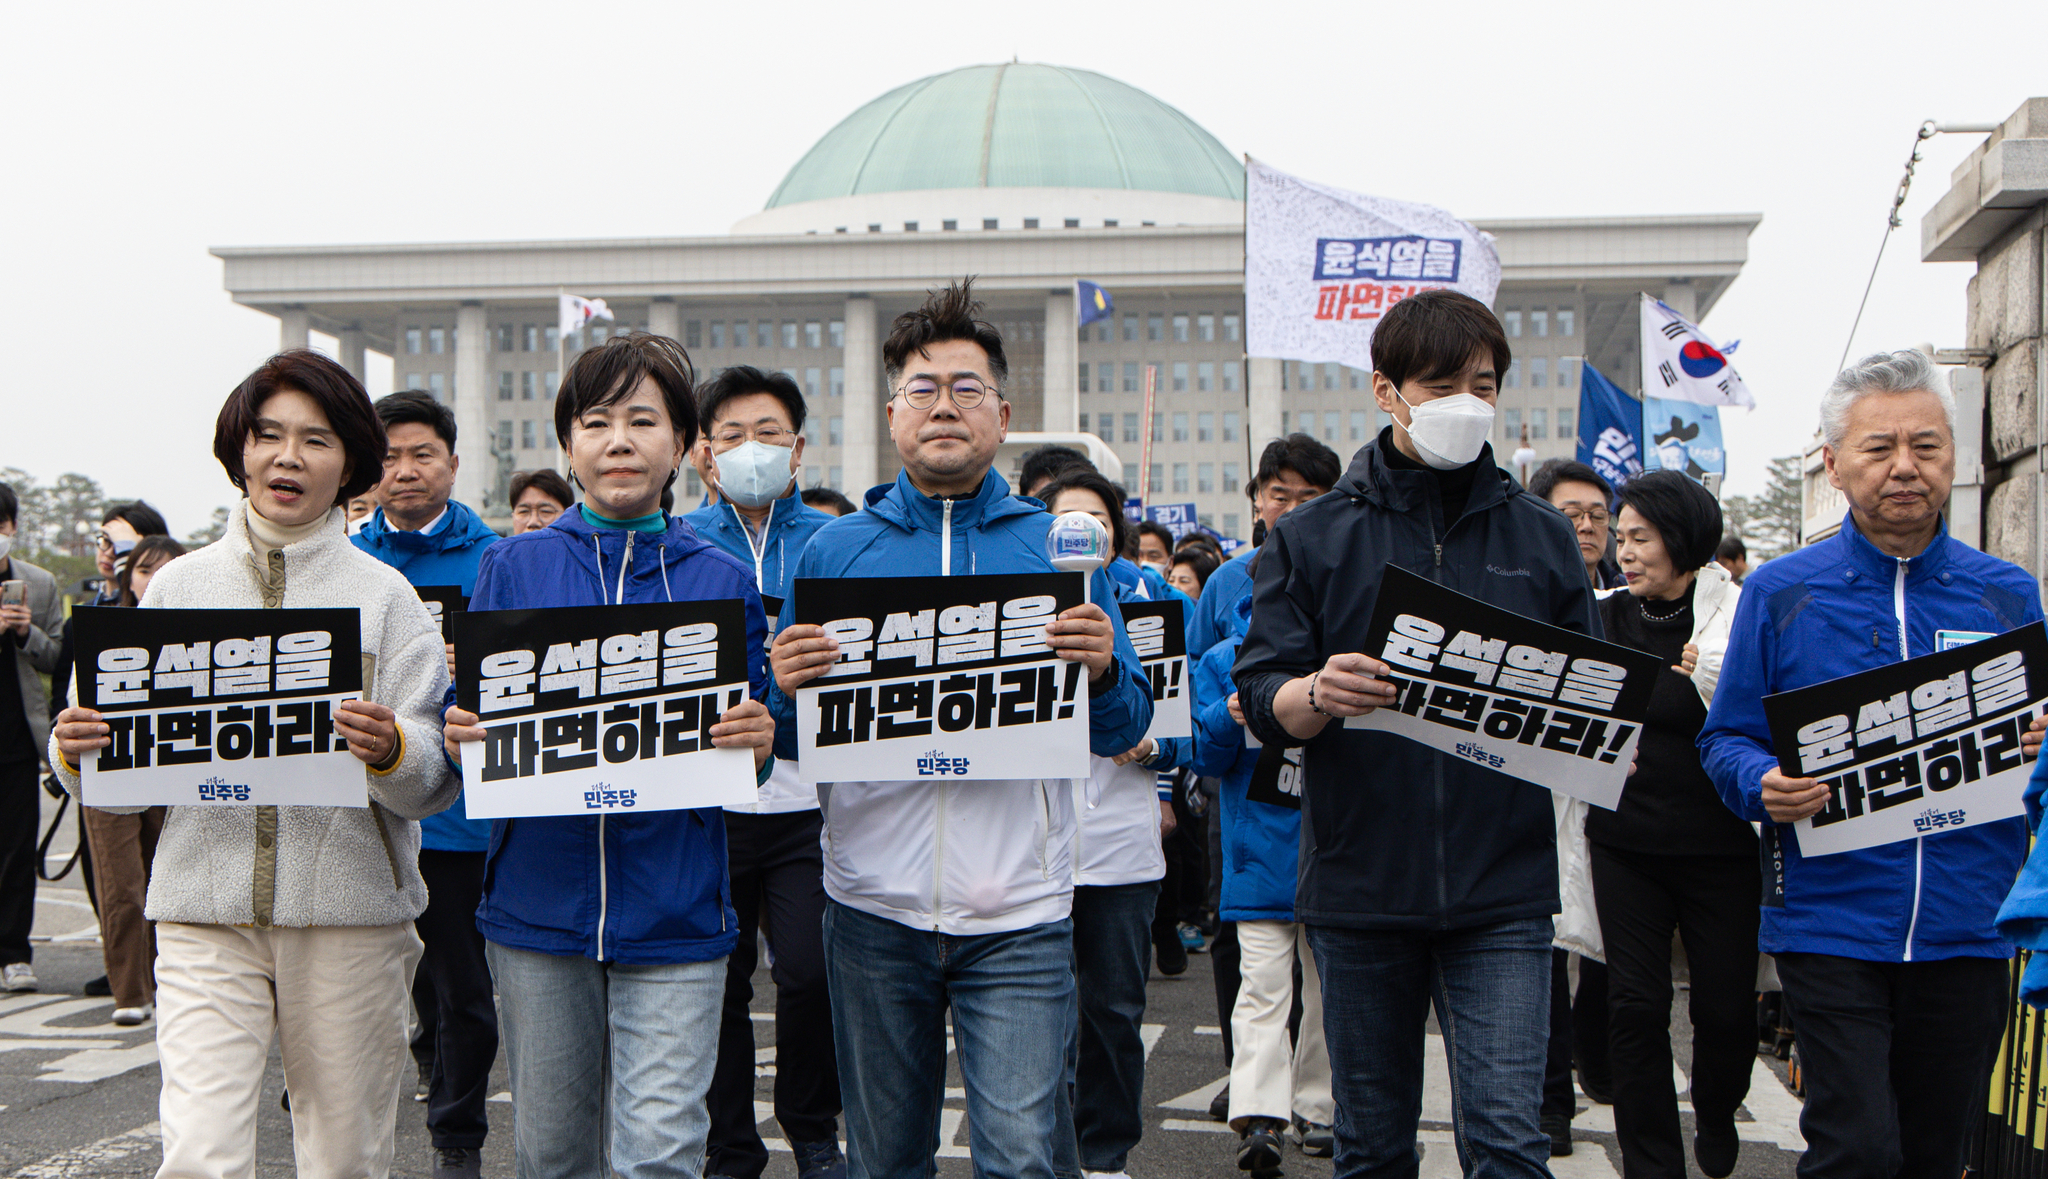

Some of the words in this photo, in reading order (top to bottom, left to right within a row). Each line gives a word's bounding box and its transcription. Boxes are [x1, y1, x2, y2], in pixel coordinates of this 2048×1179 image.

[1321, 240, 1456, 278] 윤석열을
[1065, 538, 1089, 548] 민주당
[1494, 566, 1530, 577] Columbia
[818, 595, 1056, 679] 윤석열을
[96, 630, 332, 705] 윤석열을
[479, 622, 718, 714] 윤석열을
[1380, 613, 1627, 712] 윤석열을
[816, 662, 1081, 748] 파면하라!
[1797, 651, 2029, 774] 윤석열을
[917, 758, 970, 775] 민주당
[1456, 743, 1506, 768] 민주당
[198, 785, 252, 801] 민주당
[584, 789, 637, 809] 민주당
[1913, 809, 1966, 833] 민주당
